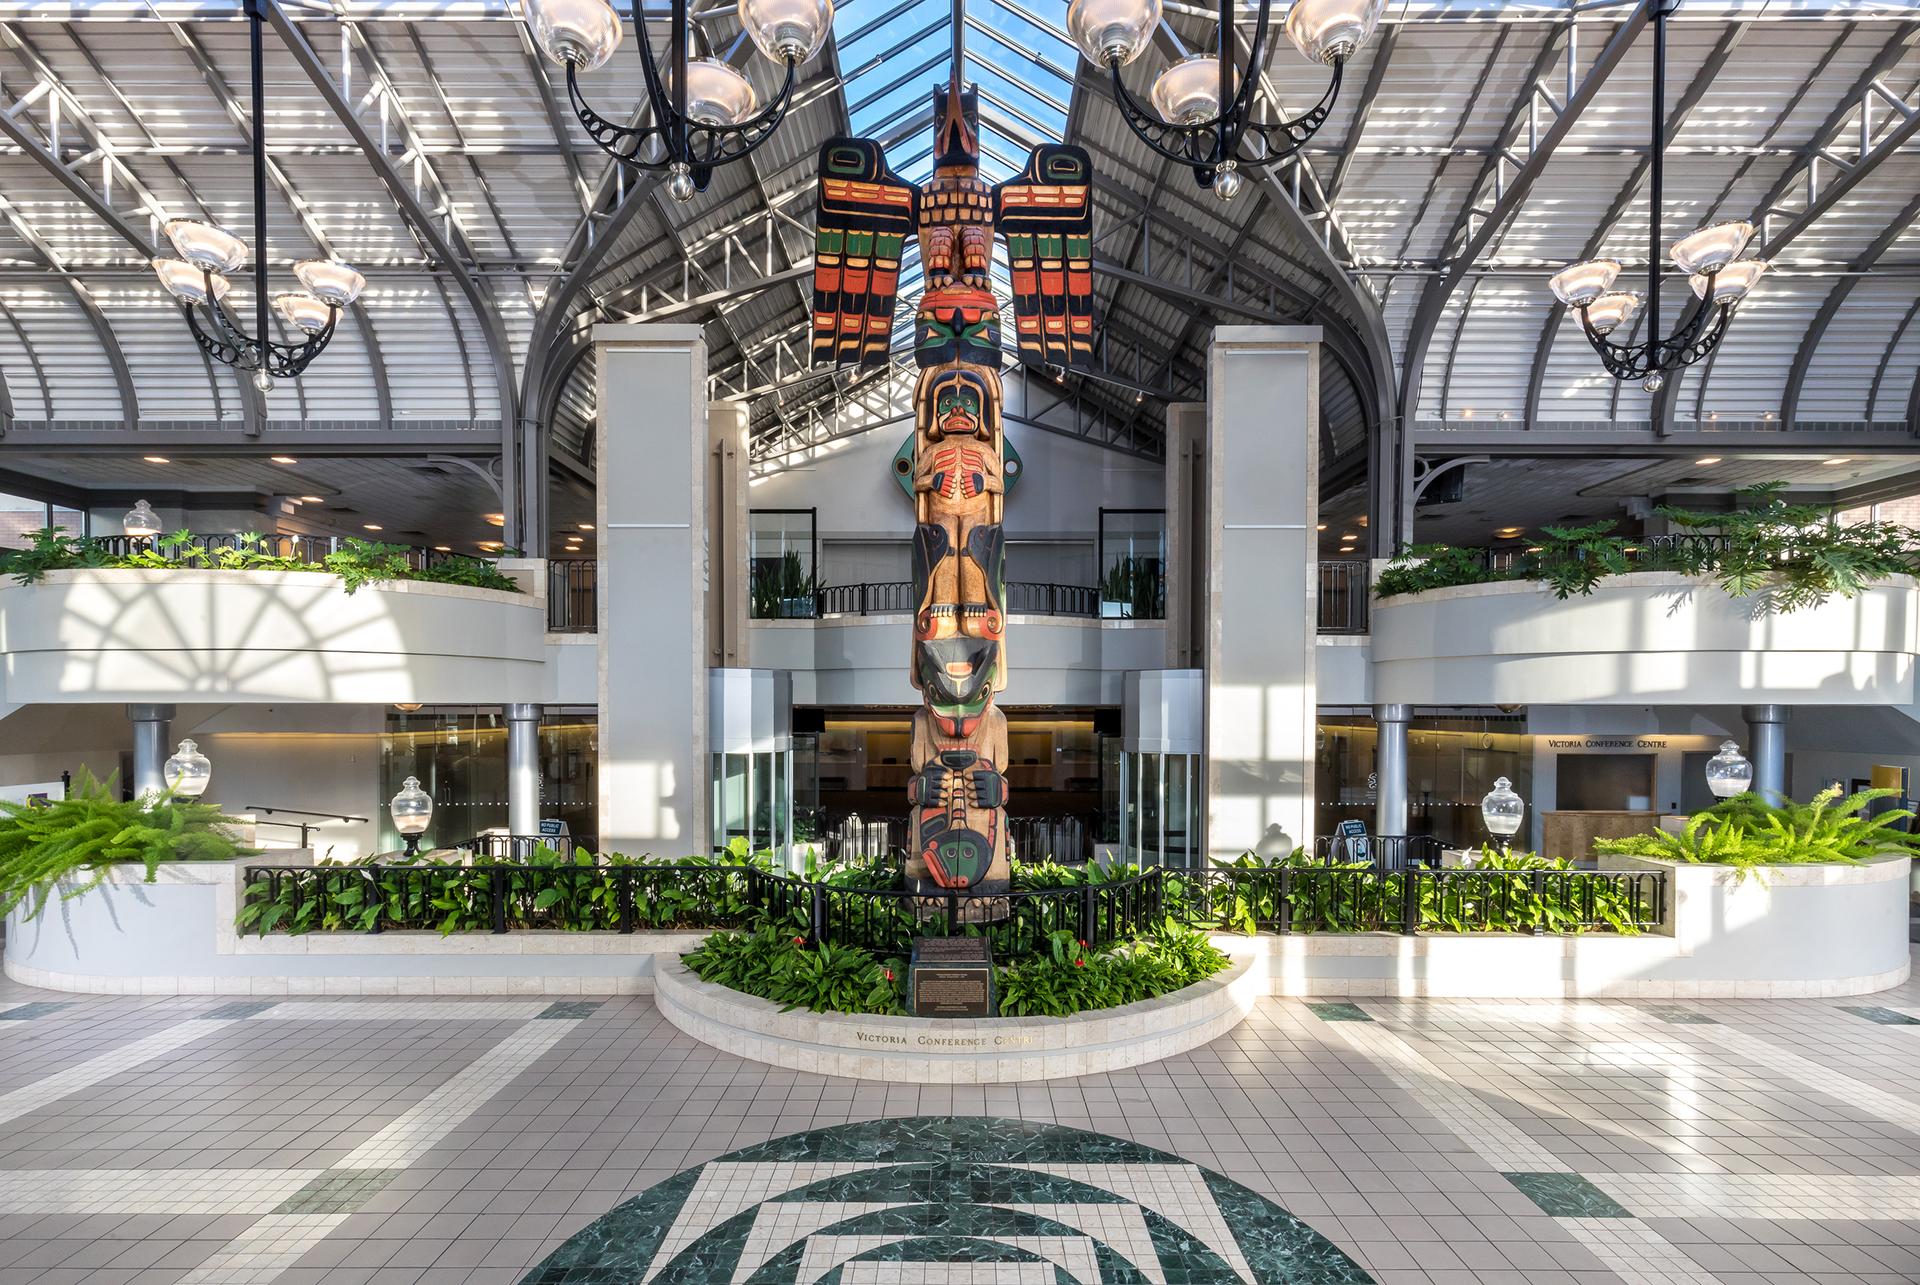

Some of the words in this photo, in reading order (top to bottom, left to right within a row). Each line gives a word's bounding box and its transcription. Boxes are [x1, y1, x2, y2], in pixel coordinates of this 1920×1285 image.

[1549, 740, 1581, 748] VICTORIA
[1585, 740, 1633, 748] CONFERENCE
[1637, 740, 1667, 748] CENTRE
[856, 1032, 907, 1045] VICTORIA
[918, 1035, 987, 1046] CONFERENCE
